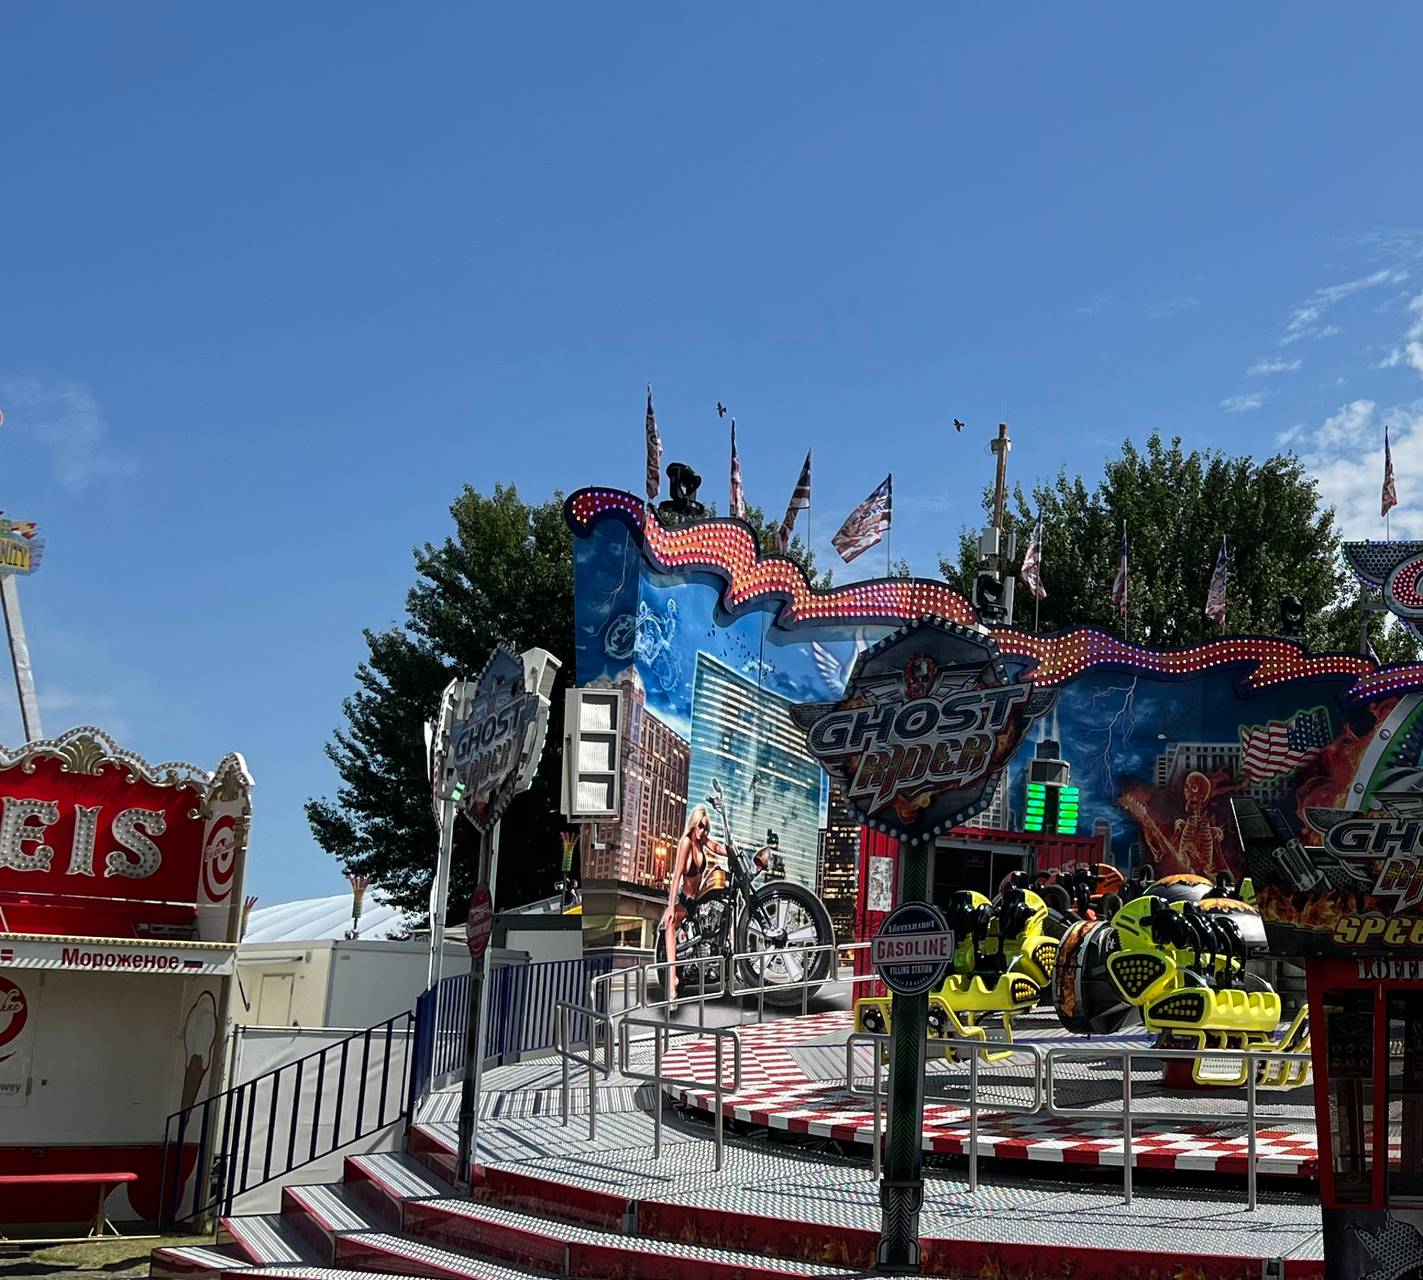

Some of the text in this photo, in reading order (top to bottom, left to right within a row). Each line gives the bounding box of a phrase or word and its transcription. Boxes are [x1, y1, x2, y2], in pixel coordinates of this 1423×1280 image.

[455, 702, 525, 763] GHOST
[808, 692, 1024, 750] GHOST
[856, 733, 992, 803] RIDER
[0, 797, 167, 879] EIS
[61, 948, 180, 971] Мороженое
[877, 937, 948, 960] GASOLINE
